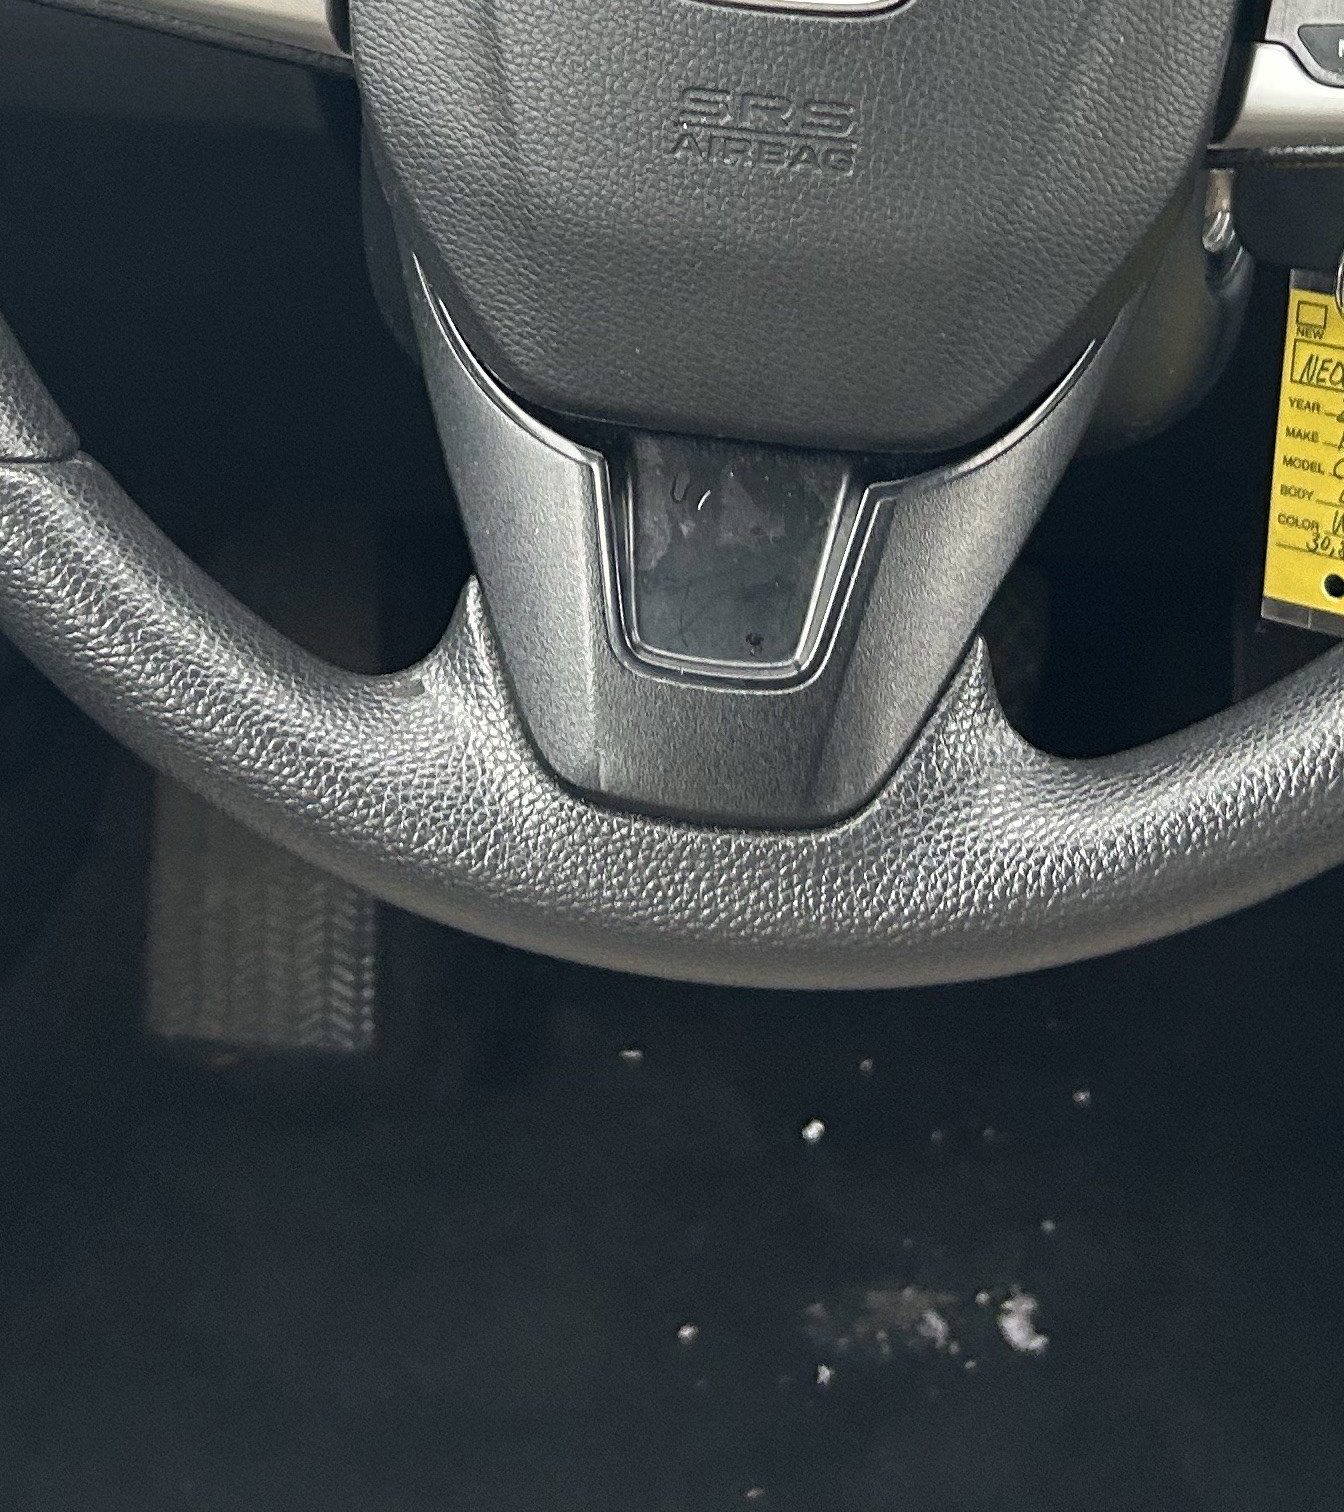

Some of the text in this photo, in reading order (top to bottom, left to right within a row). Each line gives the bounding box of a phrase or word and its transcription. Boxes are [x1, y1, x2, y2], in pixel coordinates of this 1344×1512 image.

[670, 133, 858, 177] AIRBAG
[1296, 326, 1324, 340] NEW
[1288, 396, 1321, 415] YEAR
[1285, 425, 1319, 444] MAKE
[1282, 455, 1325, 474] MODEL
[1279, 483, 1314, 501] BODY
[1277, 512, 1319, 535] COLOR
